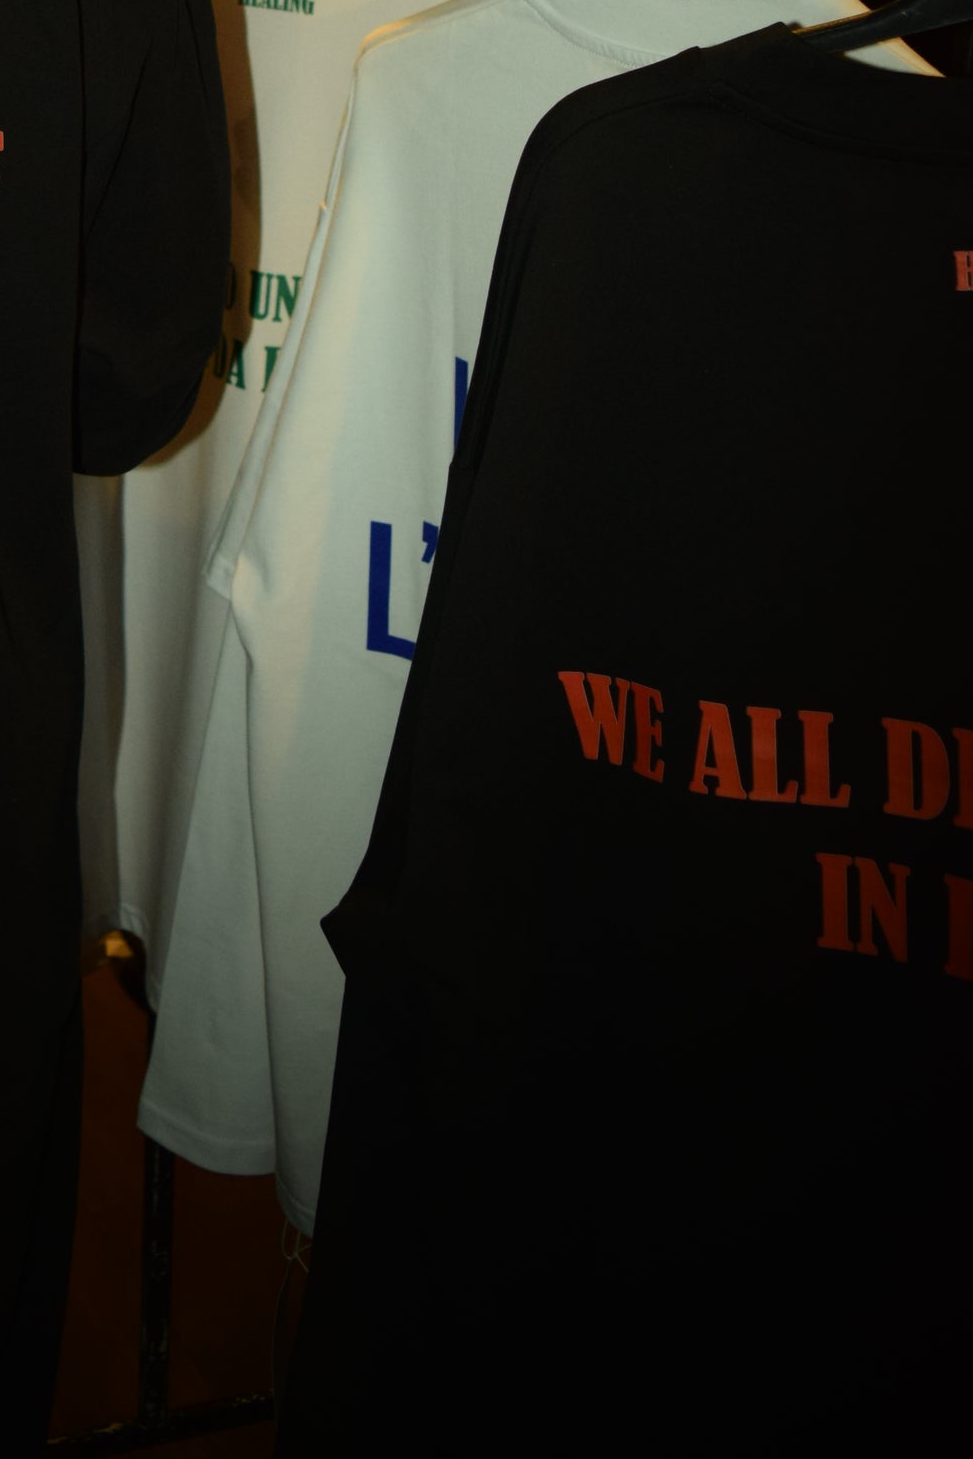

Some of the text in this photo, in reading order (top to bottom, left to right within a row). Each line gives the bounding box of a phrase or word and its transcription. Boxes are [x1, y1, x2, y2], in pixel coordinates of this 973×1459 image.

[557, 671, 666, 783] WE
[688, 700, 852, 808] ALL
[815, 852, 912, 964] IN
